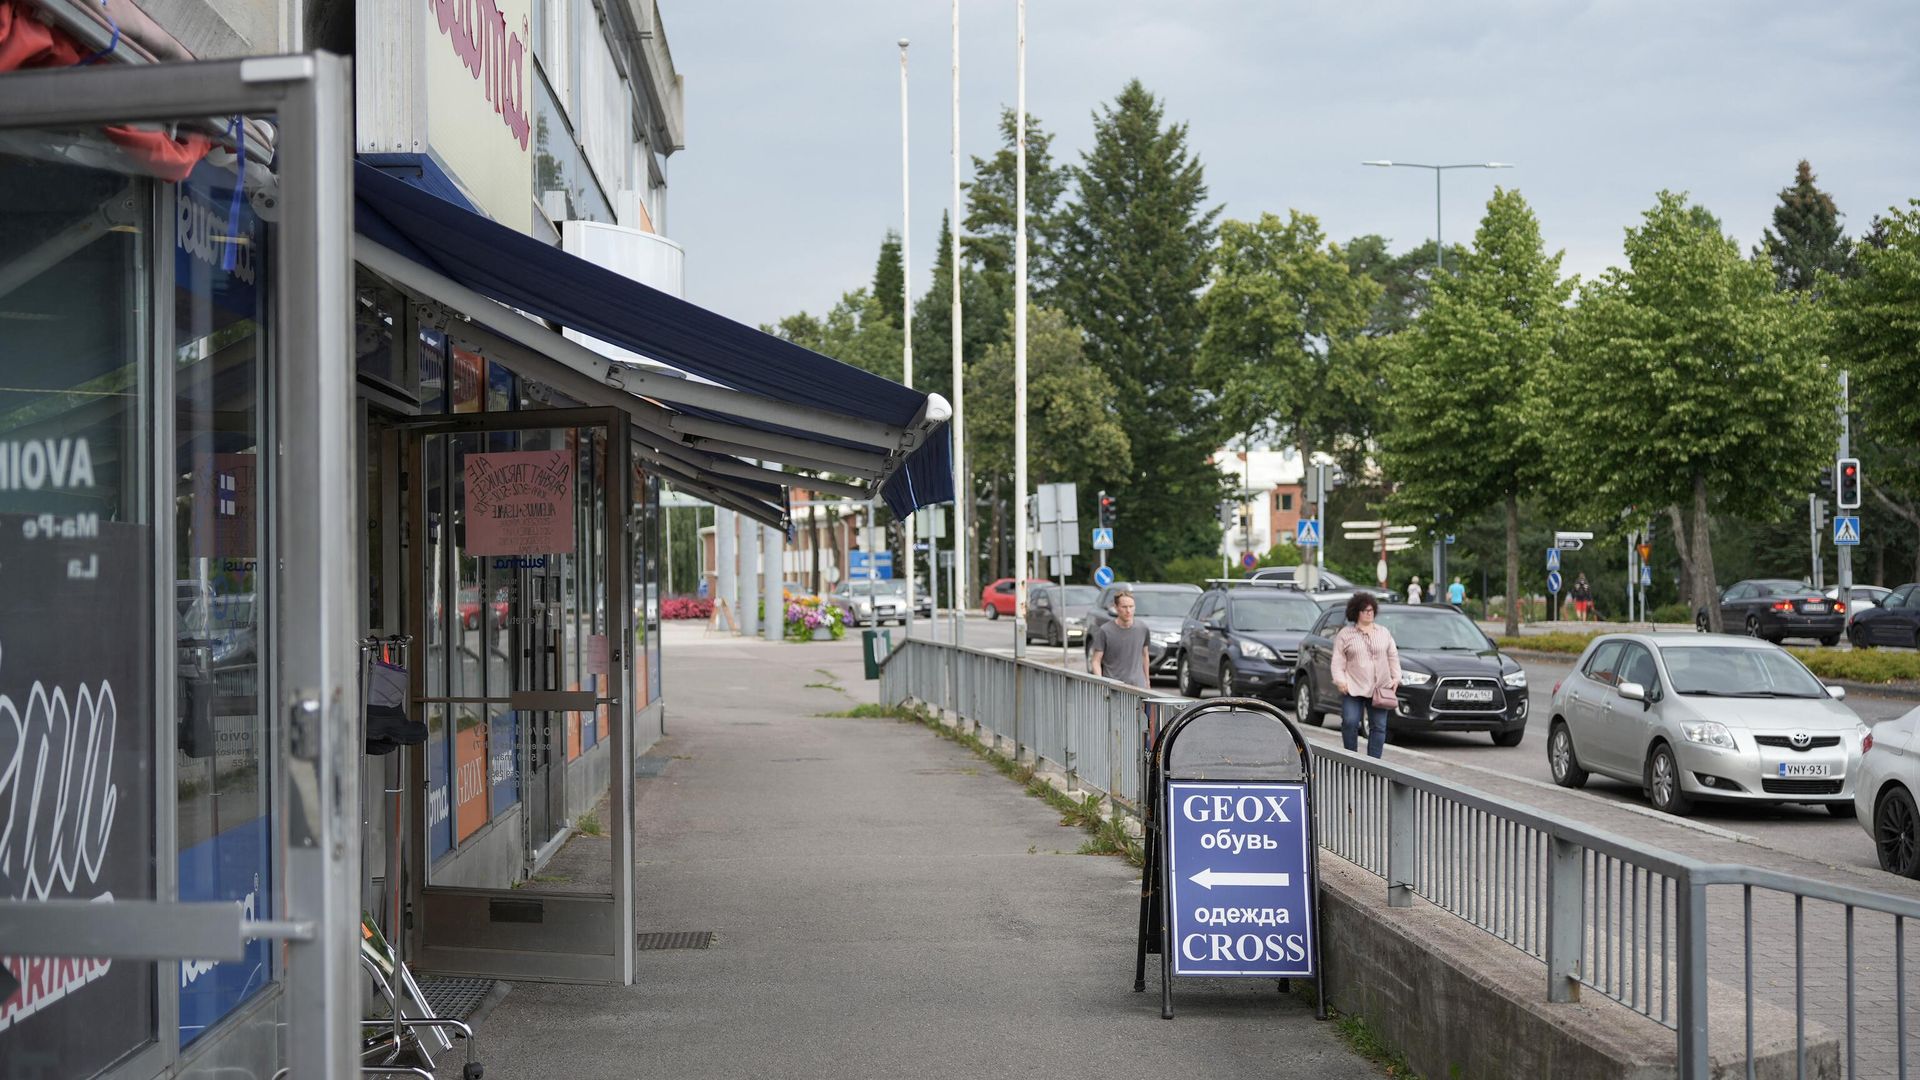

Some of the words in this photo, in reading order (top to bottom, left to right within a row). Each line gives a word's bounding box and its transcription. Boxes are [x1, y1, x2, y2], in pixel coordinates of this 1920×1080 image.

[428, 0, 530, 152] uoma
[457, 757, 483, 807] GEOX
[1183, 795, 1291, 823] GEOX
[1200, 829, 1278, 854] обувь
[1194, 907, 1290, 927] одежда
[1182, 933, 1305, 961] CROSS
